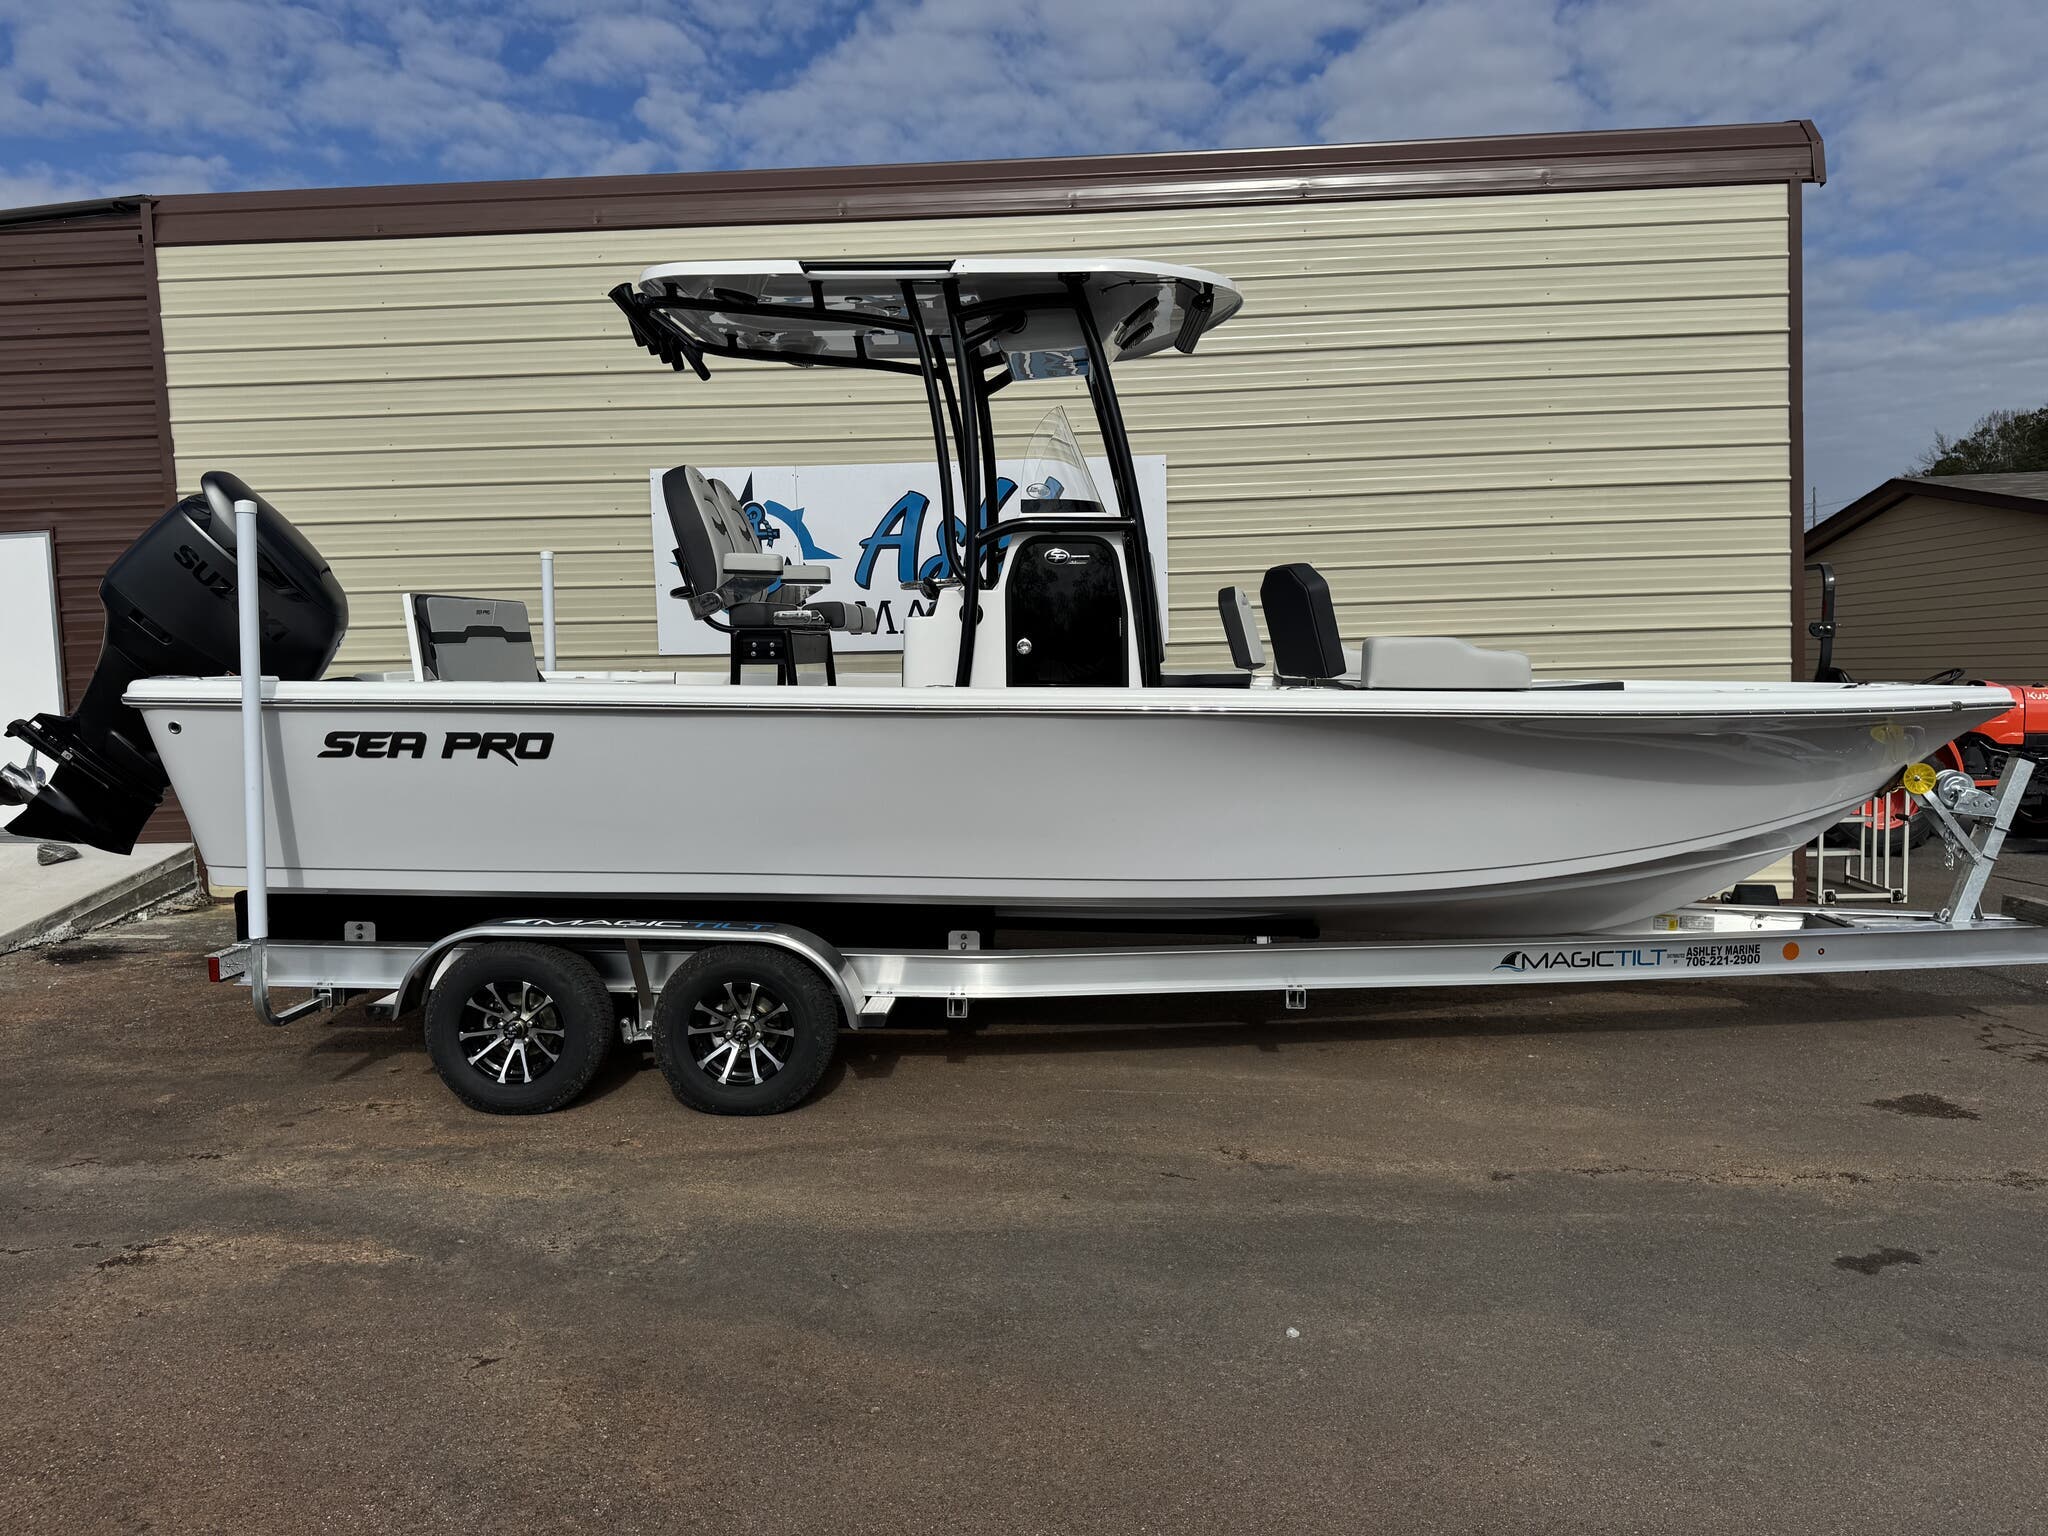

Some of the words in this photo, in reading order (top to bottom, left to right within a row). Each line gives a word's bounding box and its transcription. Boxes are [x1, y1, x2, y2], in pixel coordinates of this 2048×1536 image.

[317, 731, 427, 759] SEA
[441, 732, 555, 767] PRO
[1686, 945, 1723, 957] ASHLEY
[1725, 944, 1760, 955] MARINE
[1521, 949, 1667, 969] MAGICTILT
[1686, 954, 1760, 967] 706-221-2900
